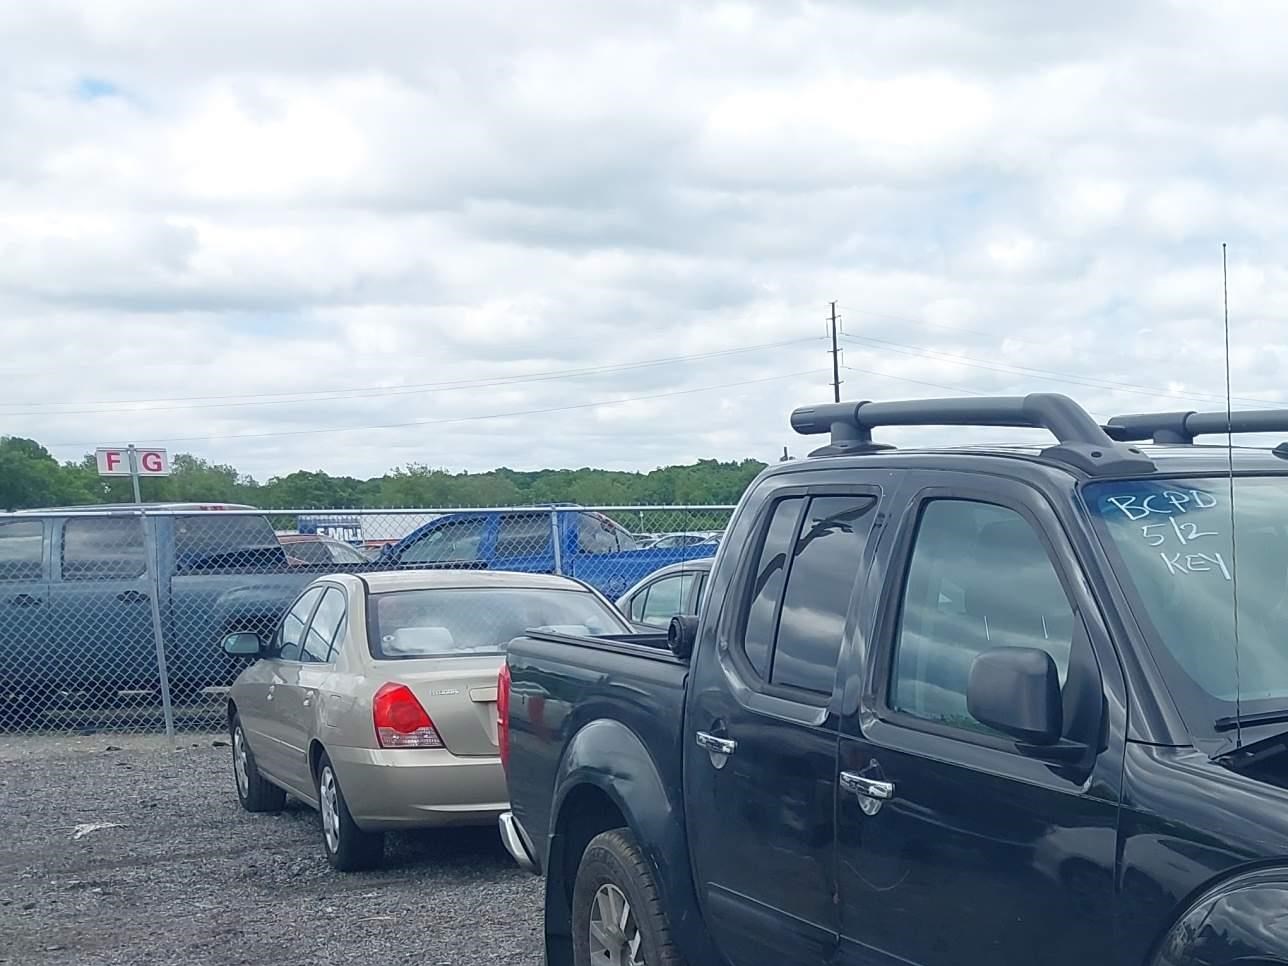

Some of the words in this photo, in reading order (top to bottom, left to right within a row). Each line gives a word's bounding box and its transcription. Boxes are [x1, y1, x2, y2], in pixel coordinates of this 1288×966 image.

[106, 451, 121, 472] F
[142, 452, 162, 473] G
[1107, 489, 1217, 521] BCPD
[1160, 552, 1232, 580] KEY
